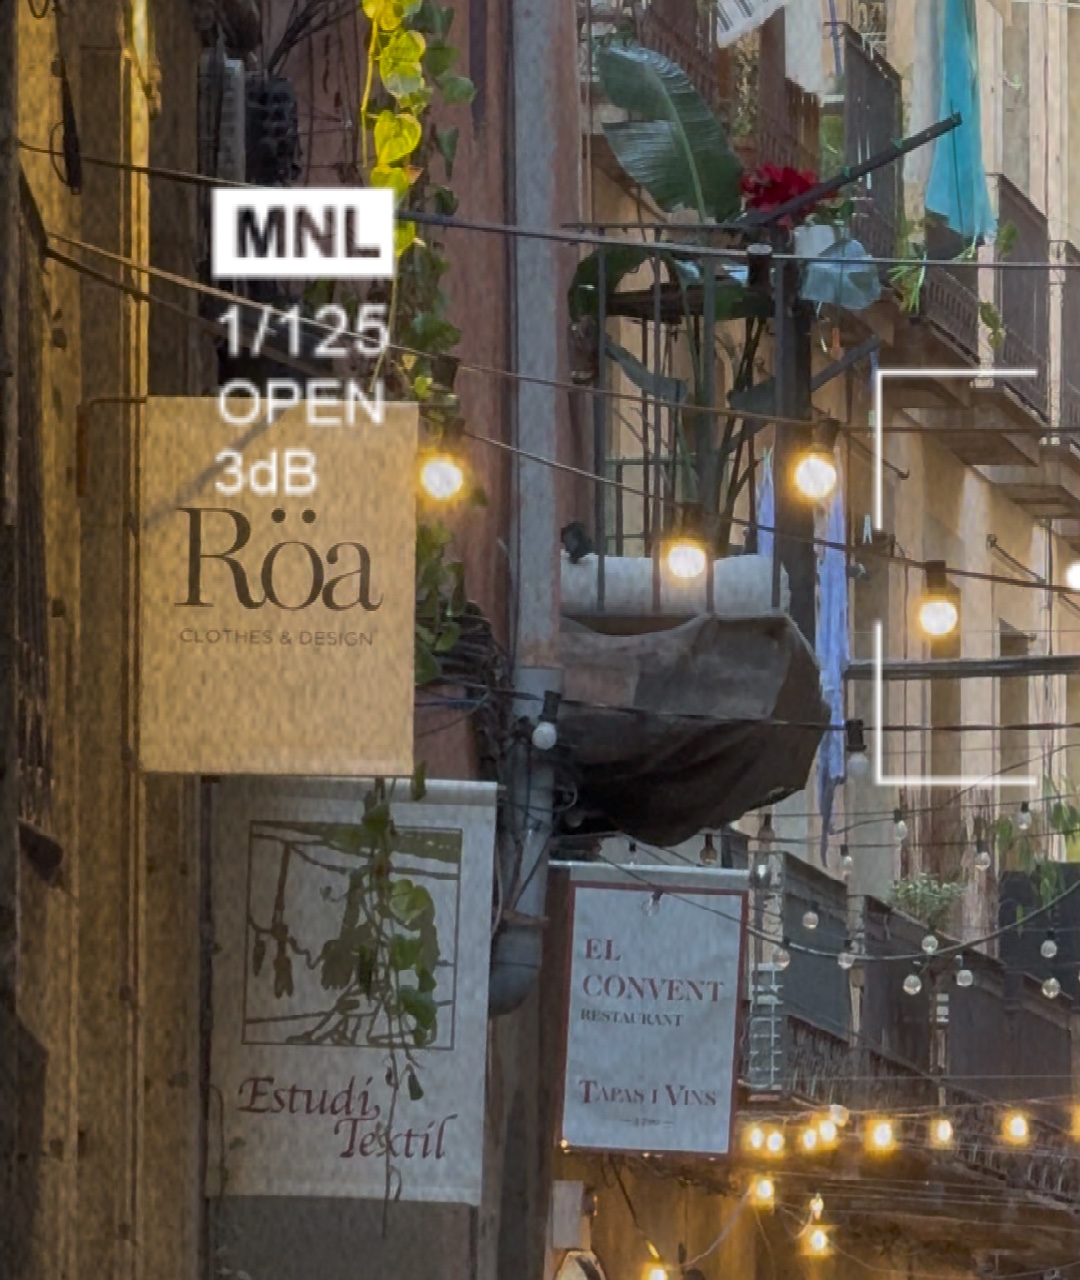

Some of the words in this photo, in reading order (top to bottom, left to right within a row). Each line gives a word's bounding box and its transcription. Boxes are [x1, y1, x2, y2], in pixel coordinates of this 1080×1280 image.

[173, 506, 384, 612] Röa
[179, 628, 274, 645] CLOTHES
[279, 629, 293, 645] &
[299, 631, 375, 647] DESIGN
[585, 937, 622, 962] EL
[582, 974, 725, 1002] CONVENT
[580, 1008, 685, 1027] RESTAURANT
[237, 1075, 380, 1120] Estudi
